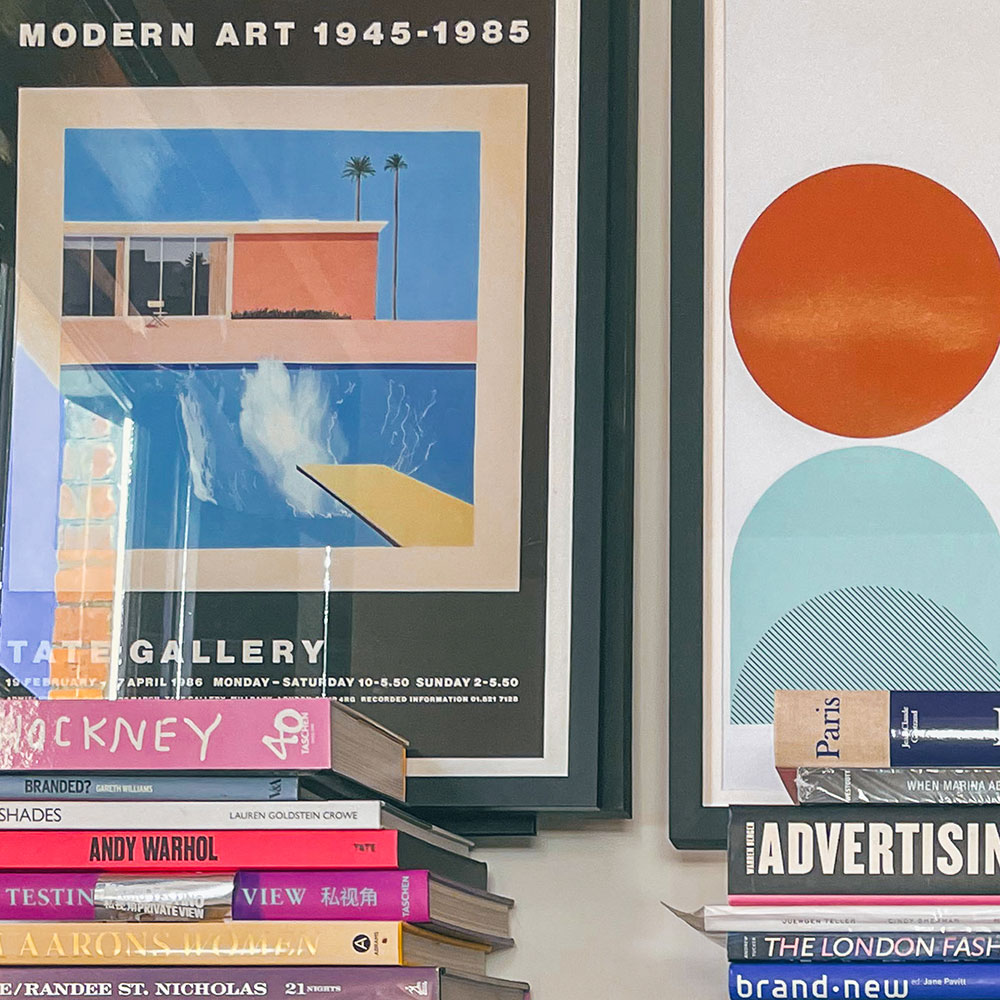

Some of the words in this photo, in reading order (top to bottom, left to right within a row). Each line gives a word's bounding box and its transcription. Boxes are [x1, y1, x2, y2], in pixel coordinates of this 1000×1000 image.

[19, 23, 196, 48] MODERN
[216, 22, 297, 47] ART
[313, 19, 531, 46] 1945-1985
[129, 639, 325, 664] GALLERY
[127, 677, 167, 688] APRIL
[416, 677, 471, 688] SUNDAY
[815, 697, 841, 759] Paris
[25, 779, 91, 794] BRANDED?
[96, 784, 121, 793] GARETH
[906, 780, 940, 791] WHEN
[942, 780, 985, 791] MARINA
[229, 811, 266, 821] LAUREN
[268, 811, 320, 821] GOLDSTEIN
[323, 811, 358, 821] CROWE
[89, 836, 136, 862] ANDY
[142, 836, 218, 862] WARHOL
[243, 887, 306, 905] VIEW
[320, 886, 378, 907] 私视角
[401, 875, 411, 917] TASCHEN
[764, 937, 816, 957] THE
[821, 937, 936, 957] LONDON
[155, 982, 267, 996] NICHOLAS
[923, 977, 943, 986] Jane
